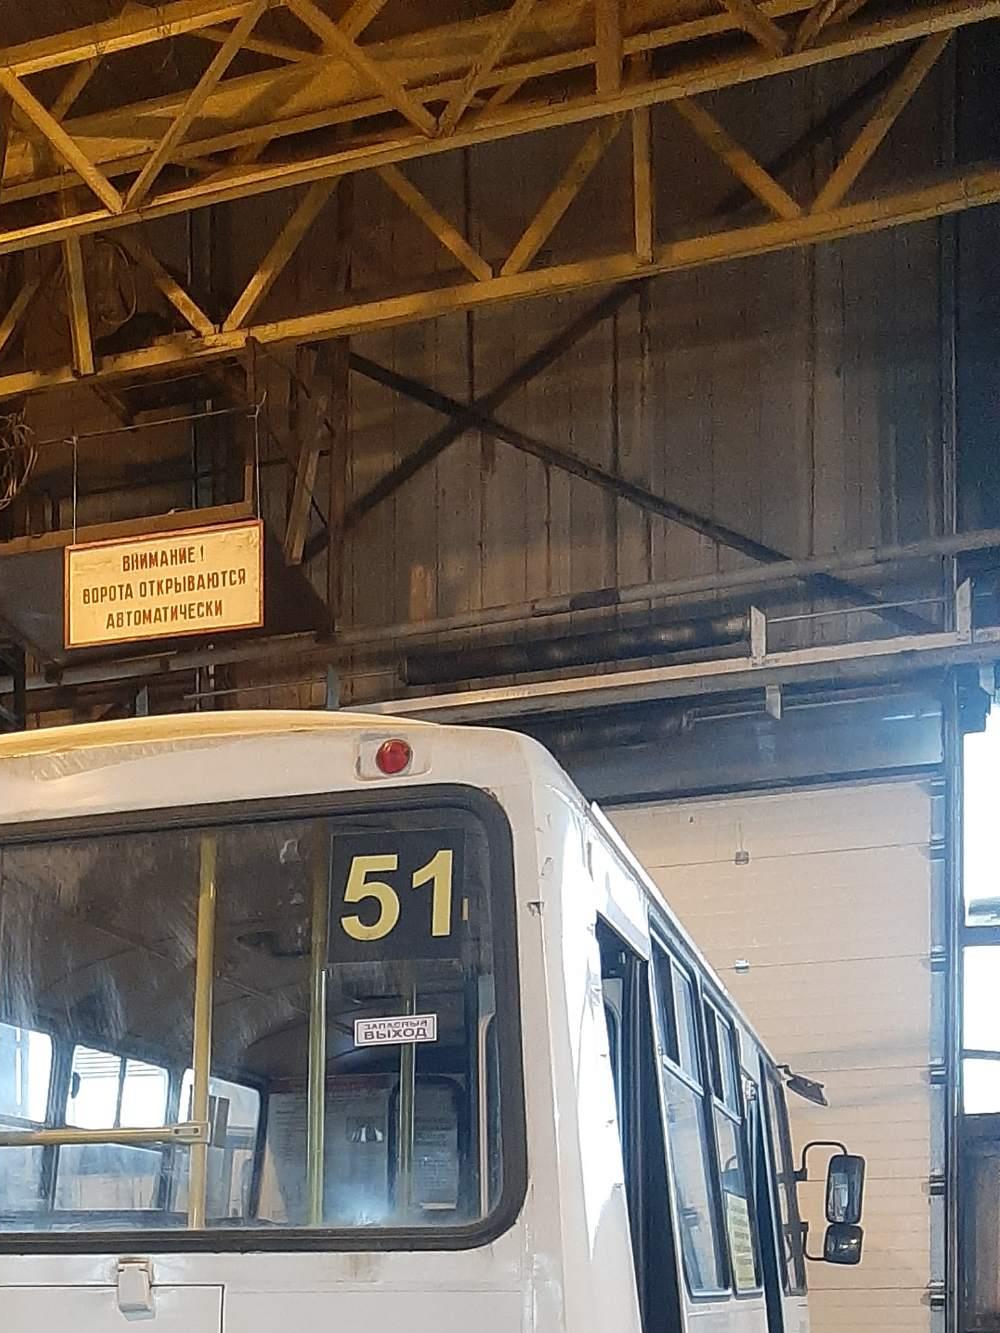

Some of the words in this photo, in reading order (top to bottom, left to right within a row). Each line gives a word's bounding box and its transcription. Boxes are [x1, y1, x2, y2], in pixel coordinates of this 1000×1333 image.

[122, 546, 195, 572] ВНИМАНИЕ
[82, 583, 134, 605] ВОРОТА
[139, 568, 247, 597] ОТКРЫВАЮТСЯ
[106, 599, 223, 630] АВТОМАТИЧЕСКИ
[340, 849, 453, 941] 51
[364, 1027, 427, 1040] ВЫХОД
